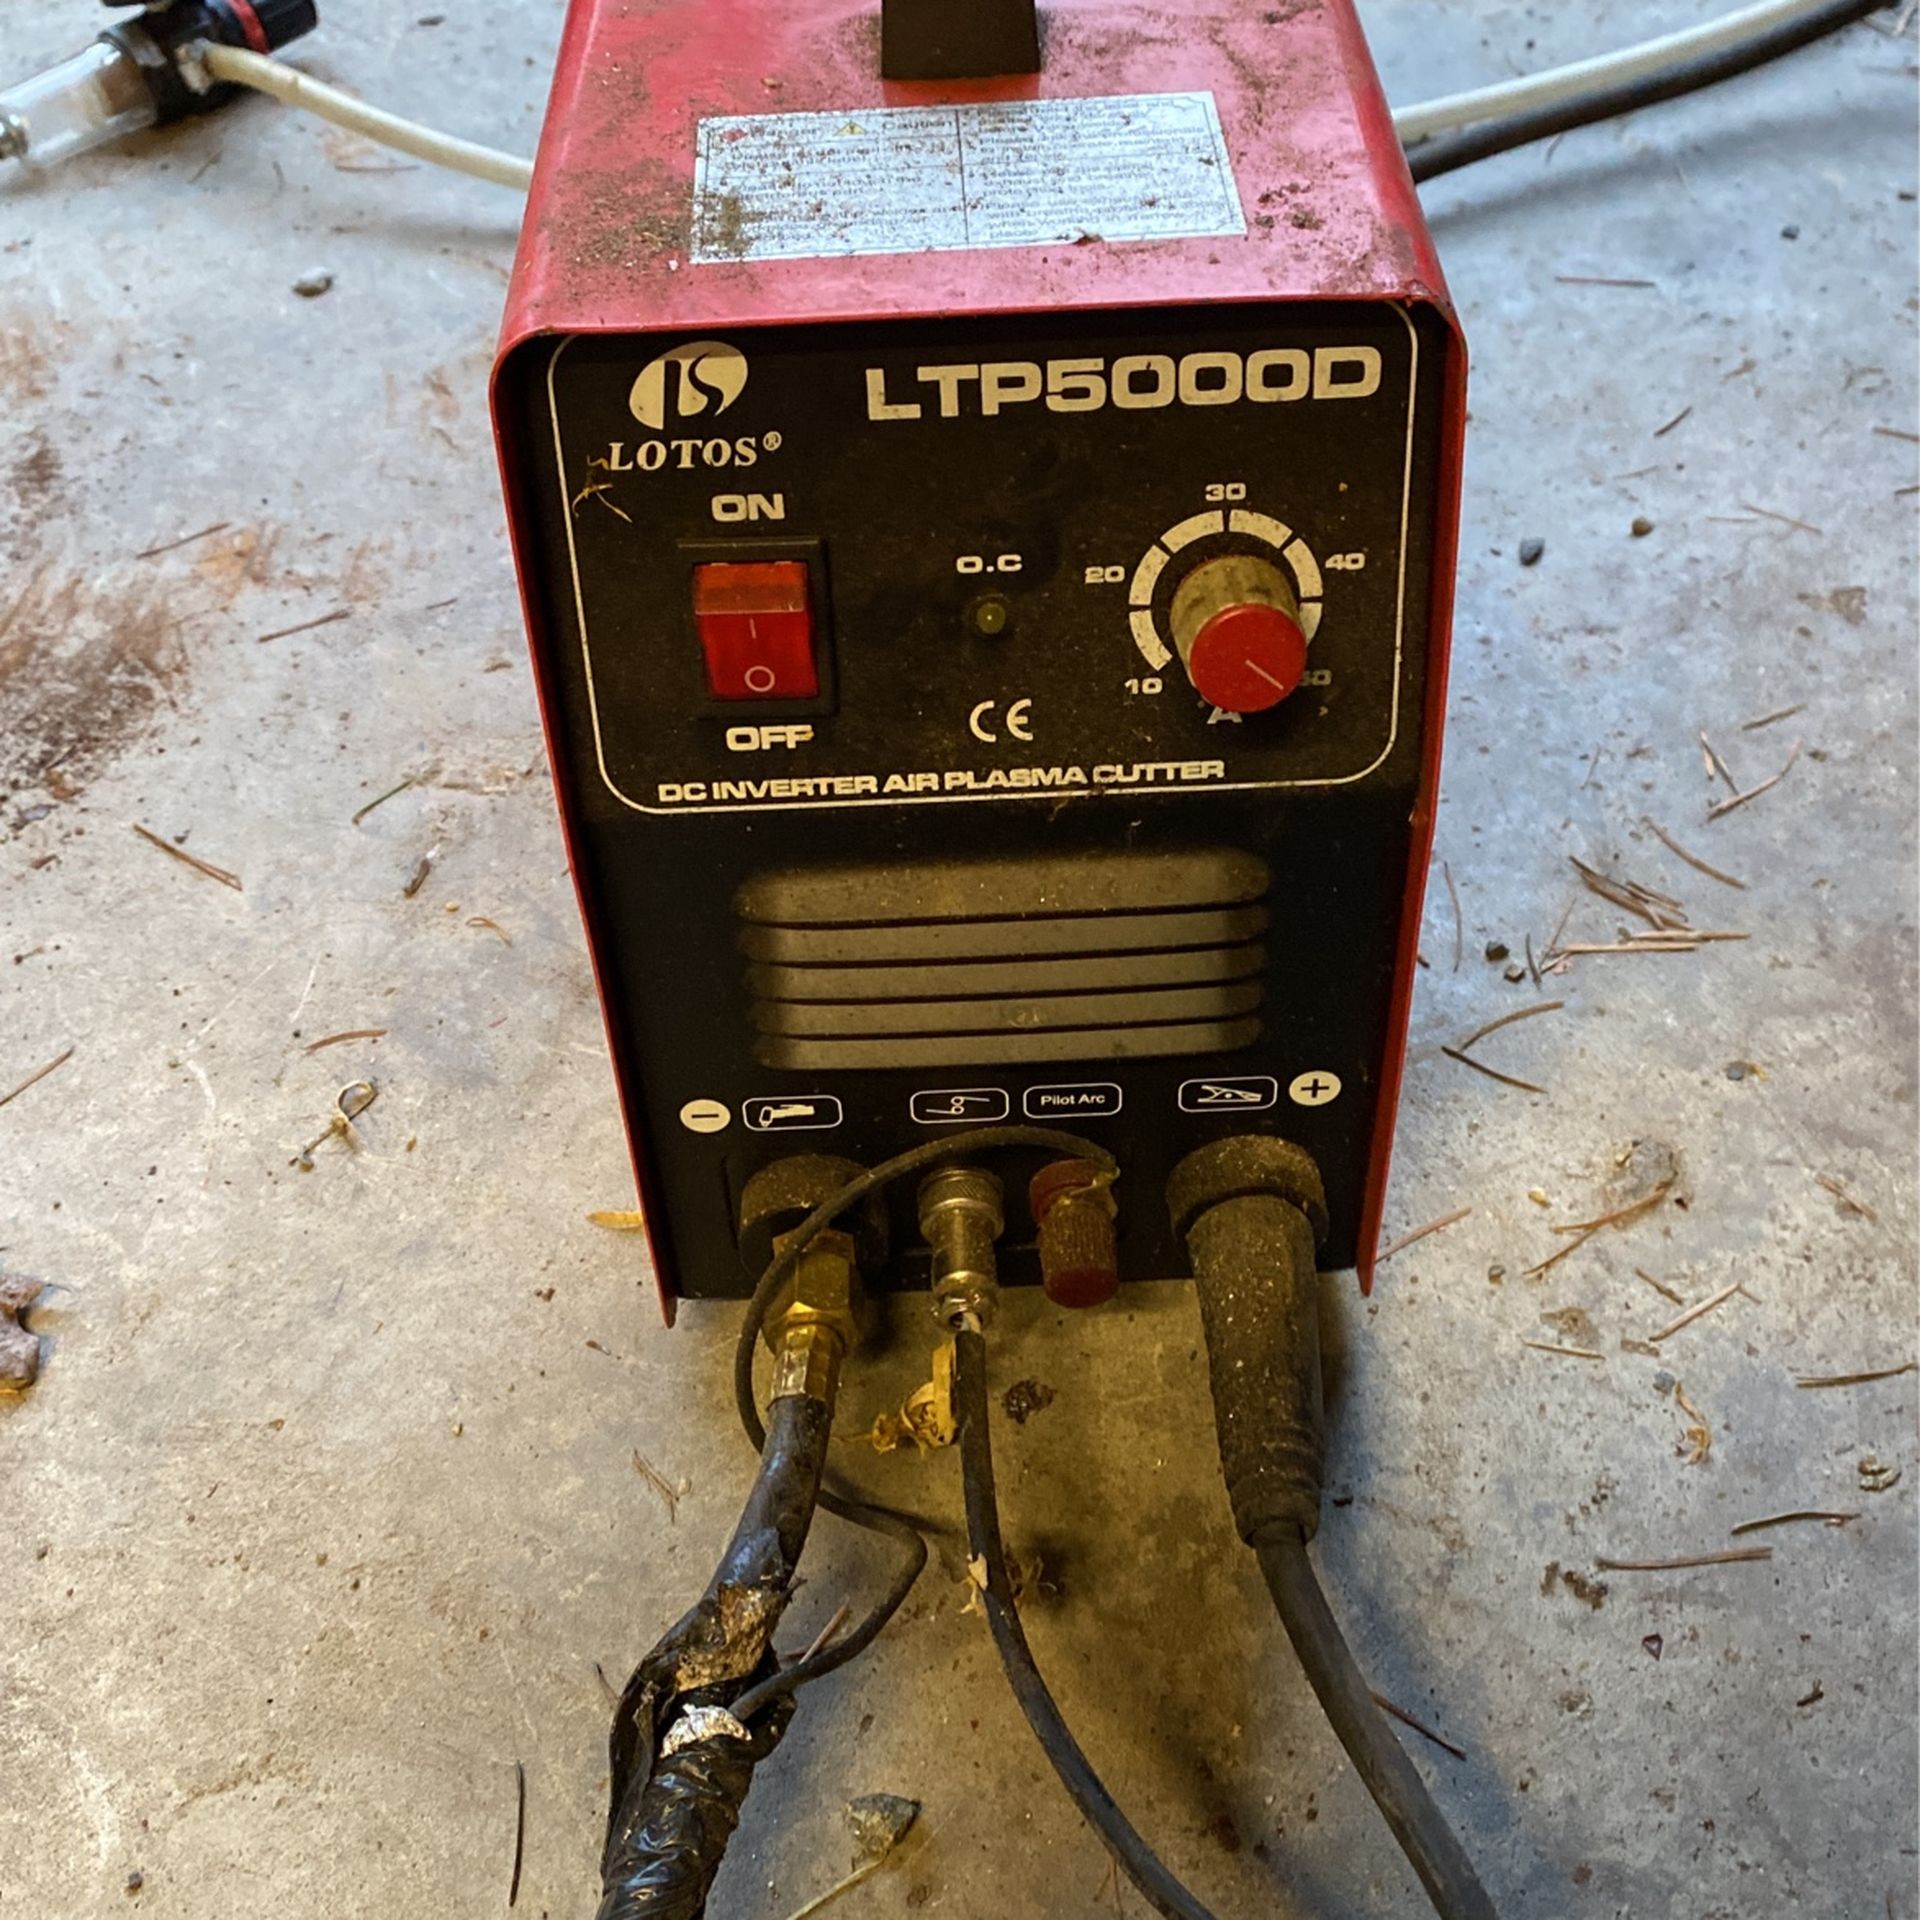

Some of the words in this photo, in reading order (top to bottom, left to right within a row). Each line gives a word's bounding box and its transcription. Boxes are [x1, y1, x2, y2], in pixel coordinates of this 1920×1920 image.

[865, 346, 1382, 421] LTP5000D
[1205, 482, 1247, 502] 30
[711, 493, 785, 522] ON
[956, 554, 1023, 574] O.C
[1324, 551, 1366, 571] 40
[1084, 565, 1125, 584] 20
[1124, 677, 1163, 695] 10
[969, 698, 1034, 743] CE
[725, 724, 814, 751] OFF
[657, 782, 706, 802] DC
[712, 775, 878, 801] INVERTER
[882, 772, 940, 793] AIR
[944, 766, 1087, 792] PLASMA
[1092, 760, 1227, 785] CUTTER
[1040, 1094, 1076, 1106] Pilot
[1078, 1093, 1106, 1104] Arc
